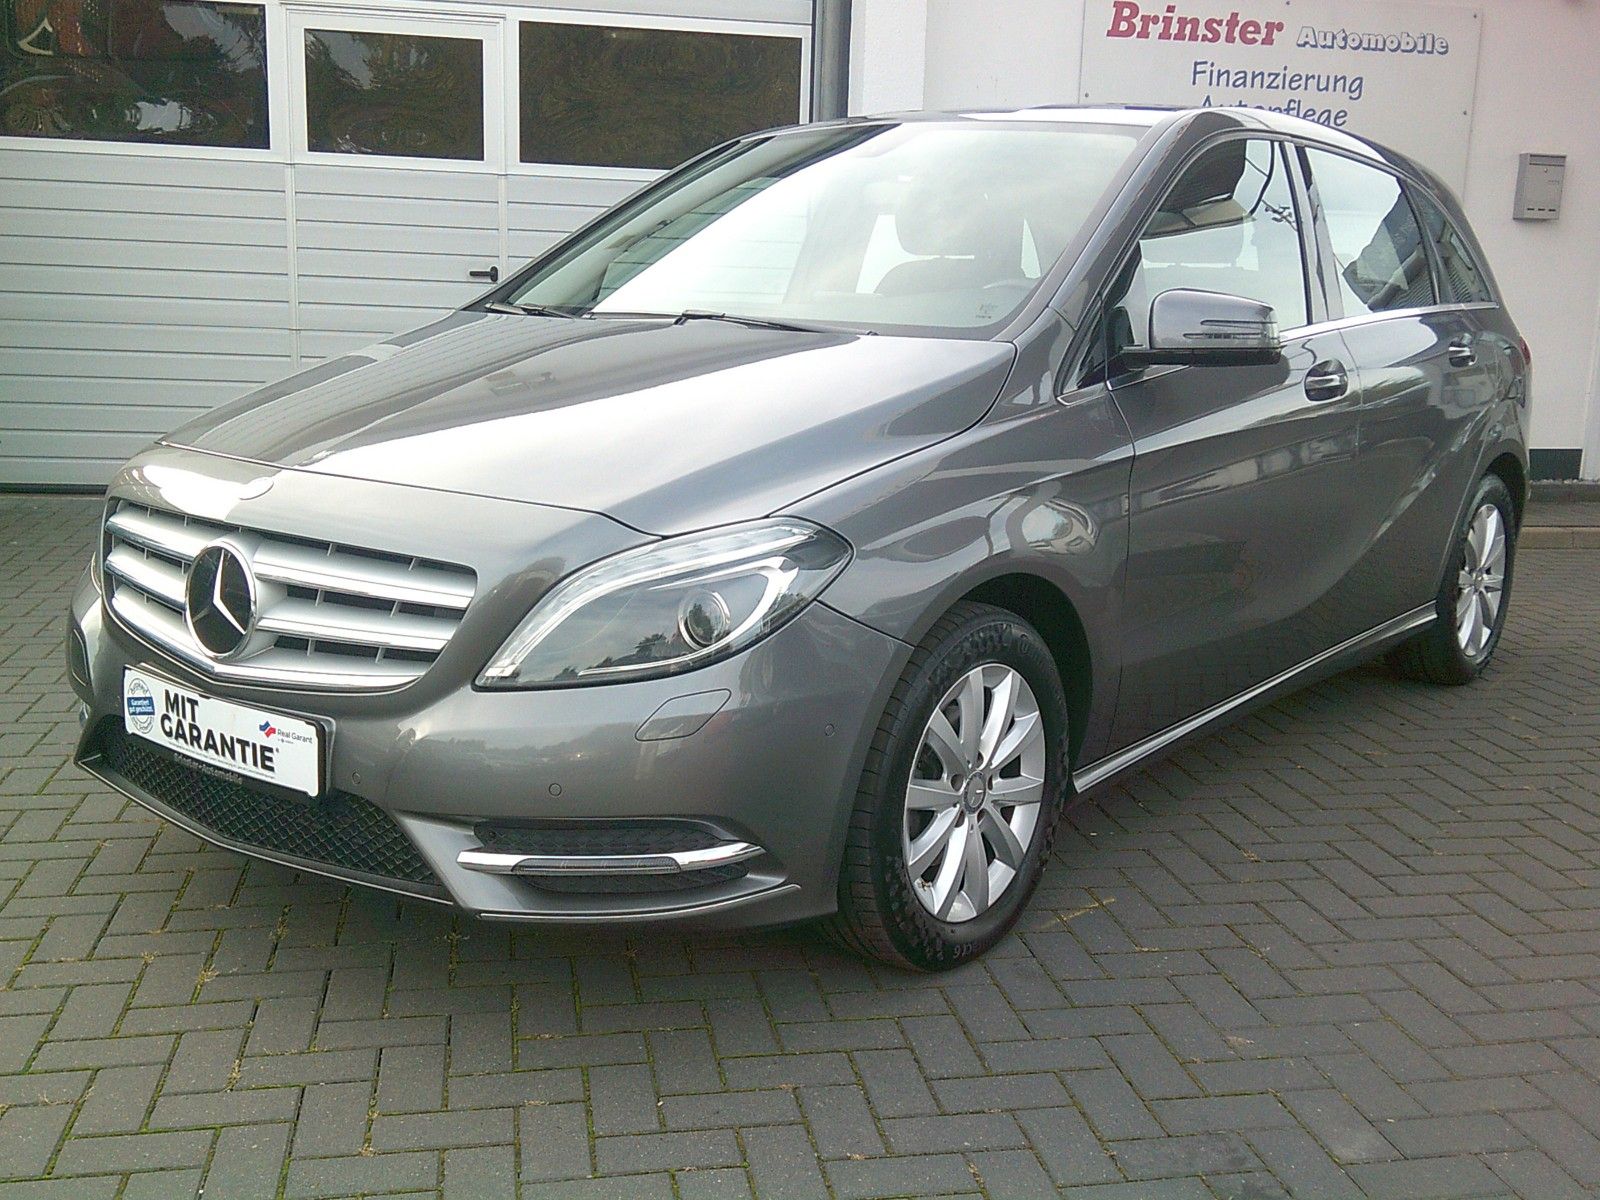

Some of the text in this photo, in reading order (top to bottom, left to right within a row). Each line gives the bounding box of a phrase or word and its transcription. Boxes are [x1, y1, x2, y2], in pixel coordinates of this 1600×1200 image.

[1106, 0, 1449, 55] Brinster Automobile
[1192, 60, 1364, 100] Finanzierung
[1202, 94, 1348, 128] Aflege
[164, 689, 199, 724] MIT
[291, 732, 314, 745] Garant
